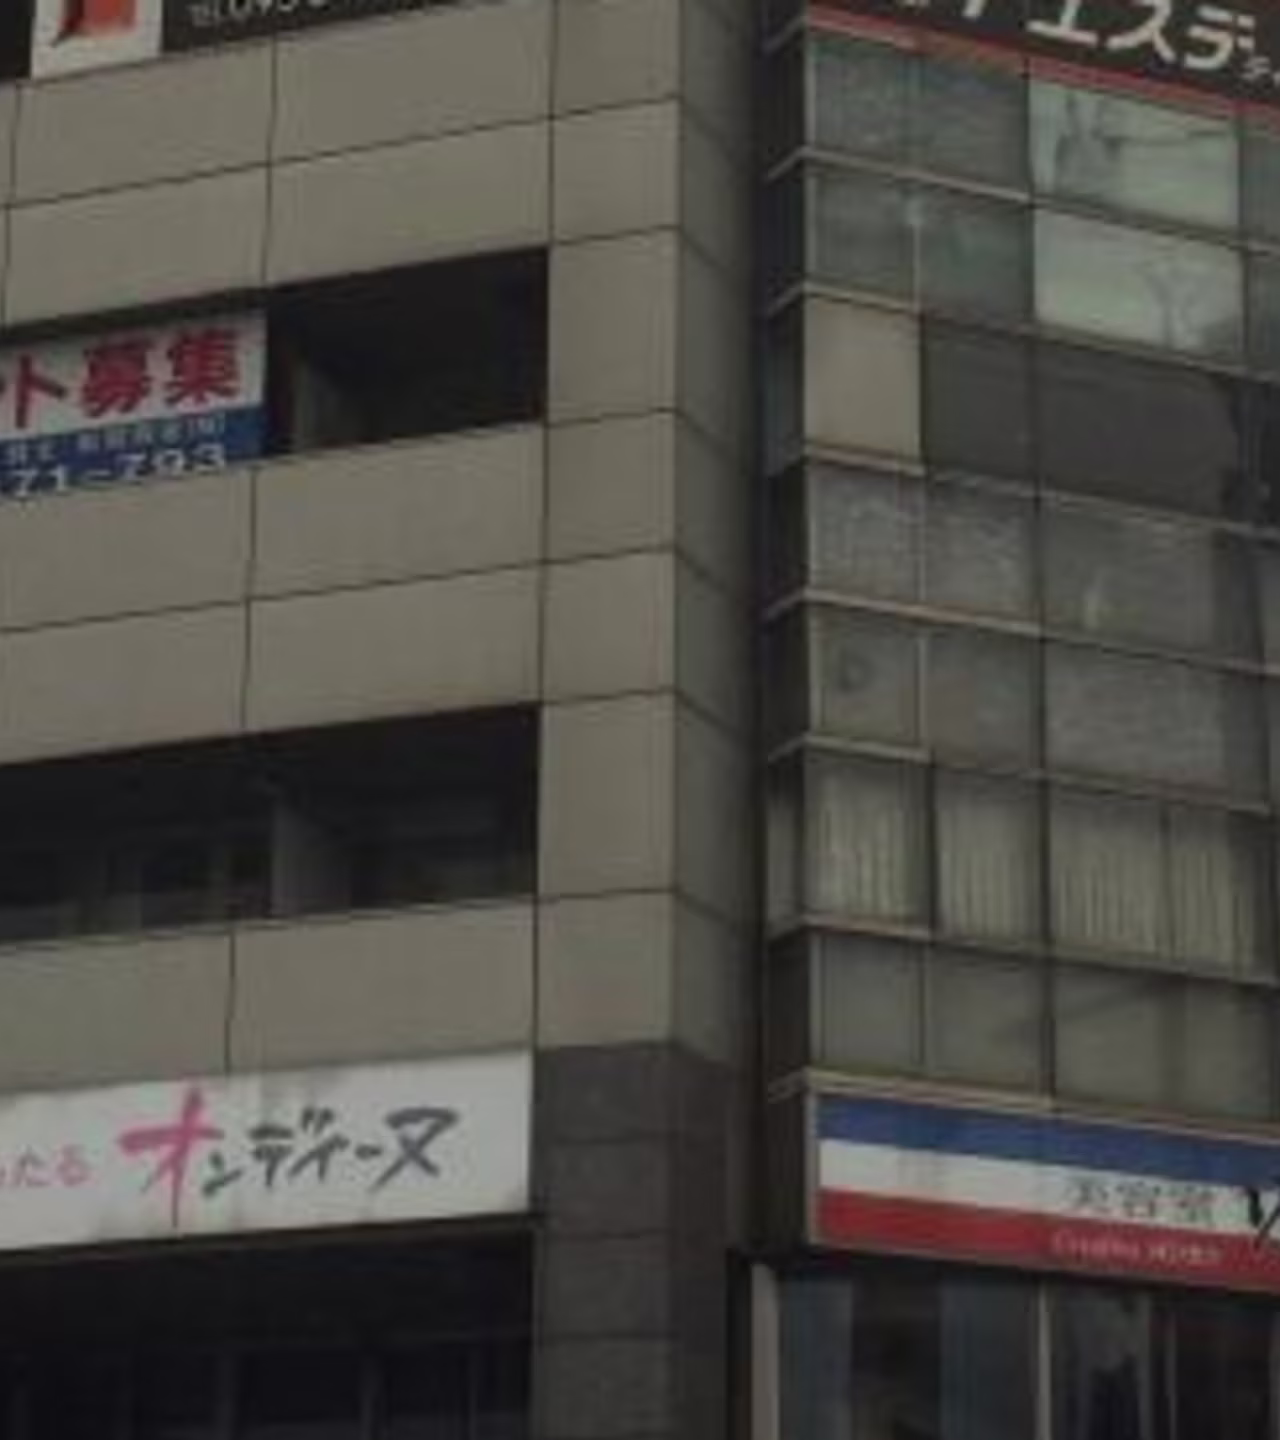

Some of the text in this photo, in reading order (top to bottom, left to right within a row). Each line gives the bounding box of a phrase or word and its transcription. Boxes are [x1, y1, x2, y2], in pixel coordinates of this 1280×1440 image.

[114, 1091, 460, 1228] オンディーヌ
